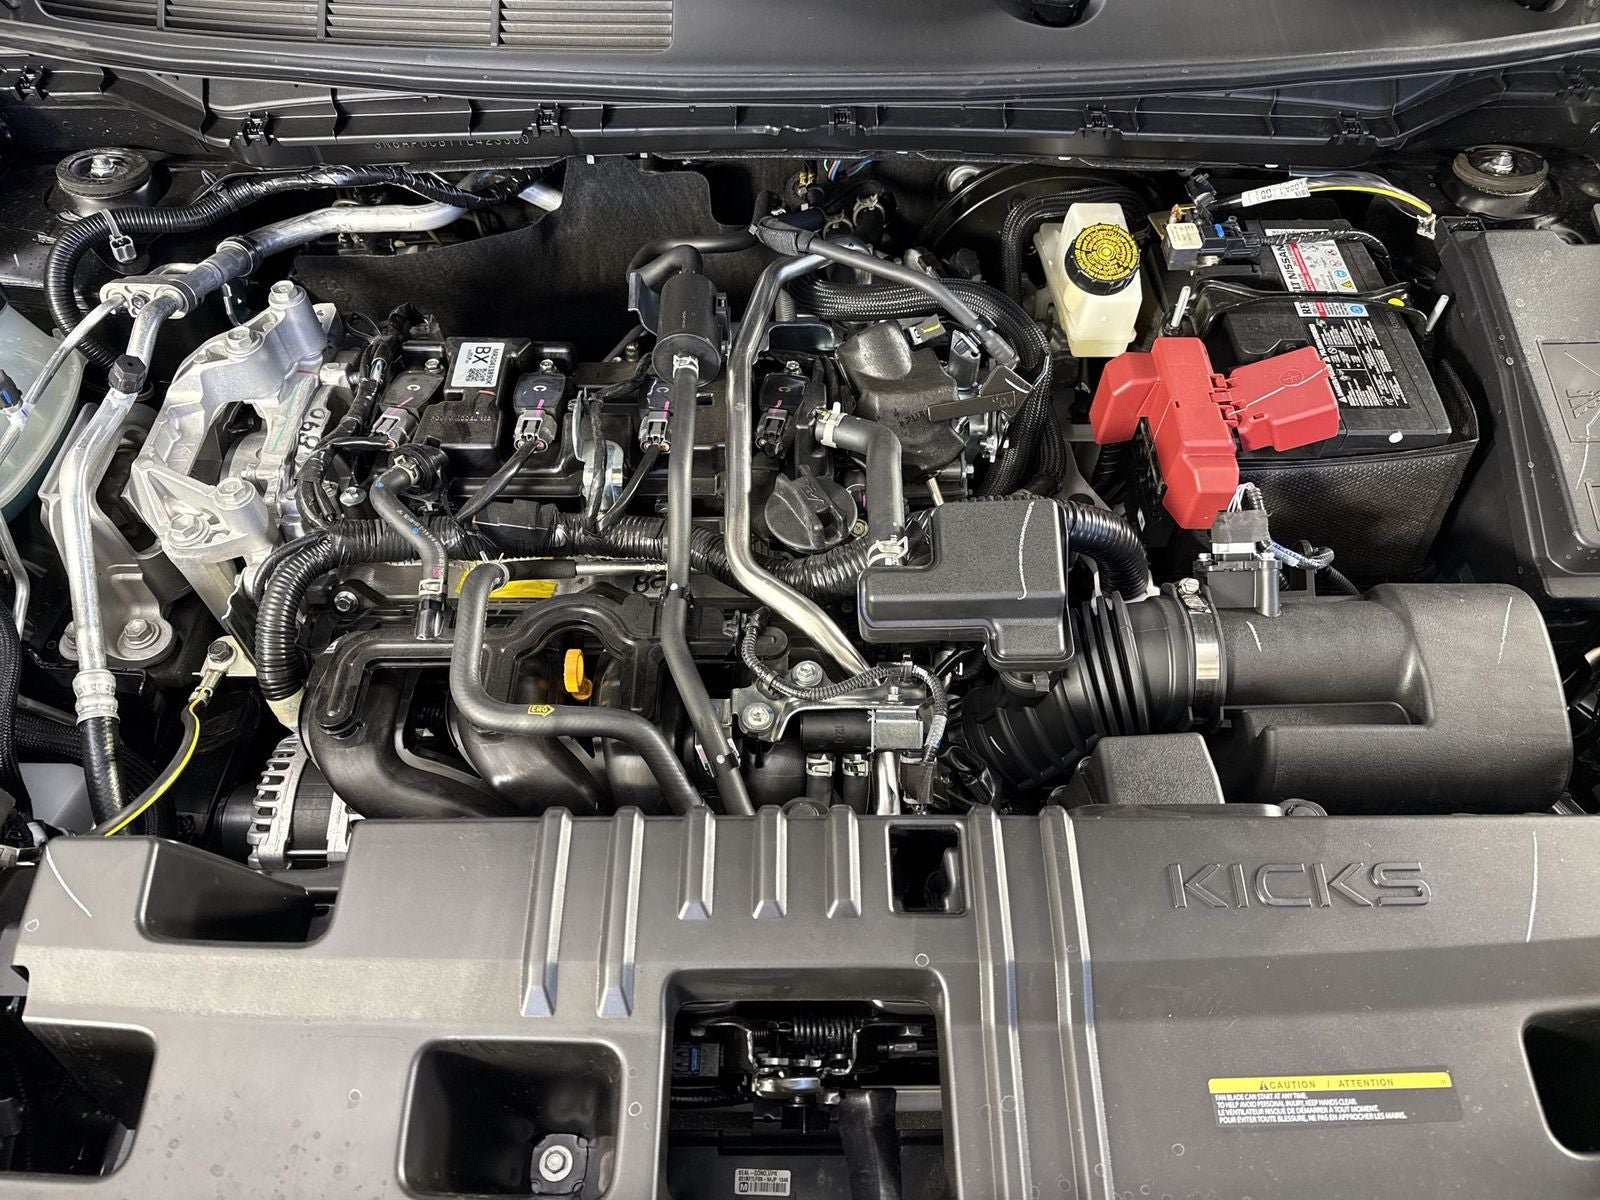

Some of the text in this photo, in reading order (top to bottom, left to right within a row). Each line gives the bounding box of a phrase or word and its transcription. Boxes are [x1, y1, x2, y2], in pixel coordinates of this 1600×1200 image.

[1276, 243, 1298, 280] NISSAN
[472, 346, 492, 364] BX
[1166, 862, 1433, 908] KICKS
[1269, 1080, 1317, 1090] CAUTION
[1338, 1078, 1395, 1088] ATTENTION
[1217, 1108, 1225, 1116] LE
[1334, 1105, 1350, 1113] TOUT
[1219, 1116, 1236, 1124] POUR
[1257, 1115, 1277, 1123] TOUTE
[1317, 1113, 1329, 1122] PAS
